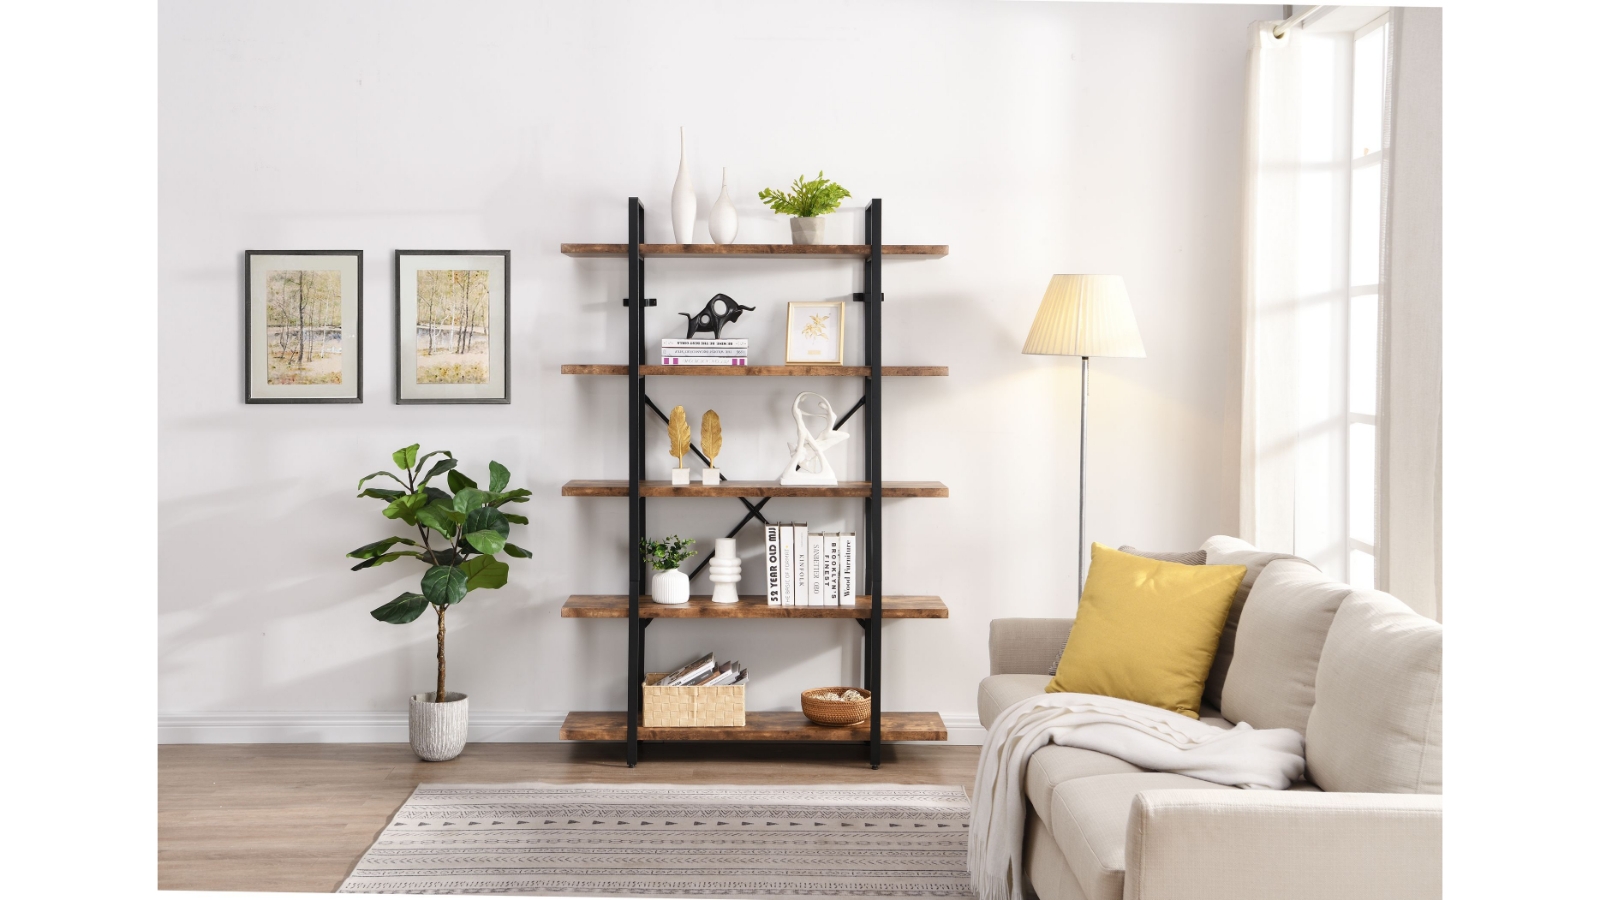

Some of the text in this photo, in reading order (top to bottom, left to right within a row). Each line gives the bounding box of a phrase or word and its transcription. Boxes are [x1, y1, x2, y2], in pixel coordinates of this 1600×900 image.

[768, 544, 777, 563] OLD
[769, 565, 778, 588] YEAR
[770, 590, 779, 602] 52
